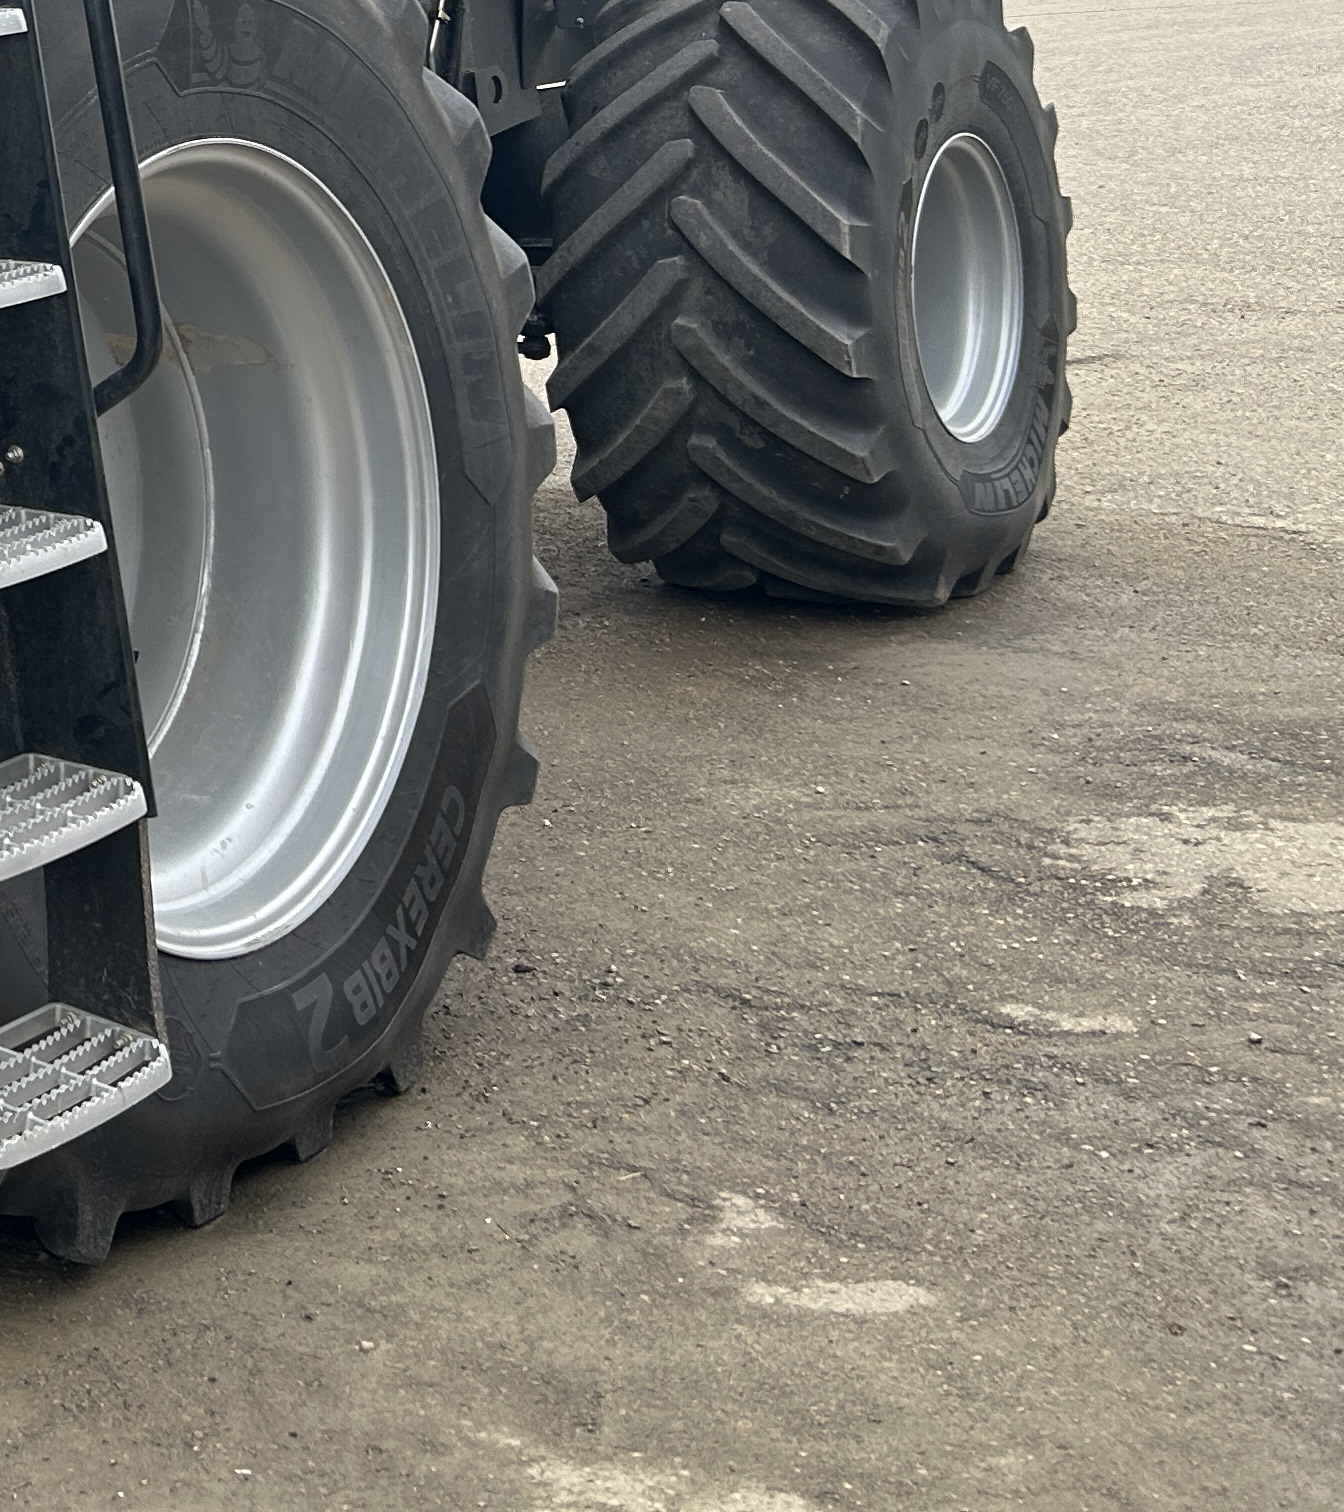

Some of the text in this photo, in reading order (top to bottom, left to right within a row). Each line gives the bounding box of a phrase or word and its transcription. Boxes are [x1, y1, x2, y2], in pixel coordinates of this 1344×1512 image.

[973, 393, 1049, 512] MICHELIN
[291, 785, 466, 1073] CEREXBIB 2
